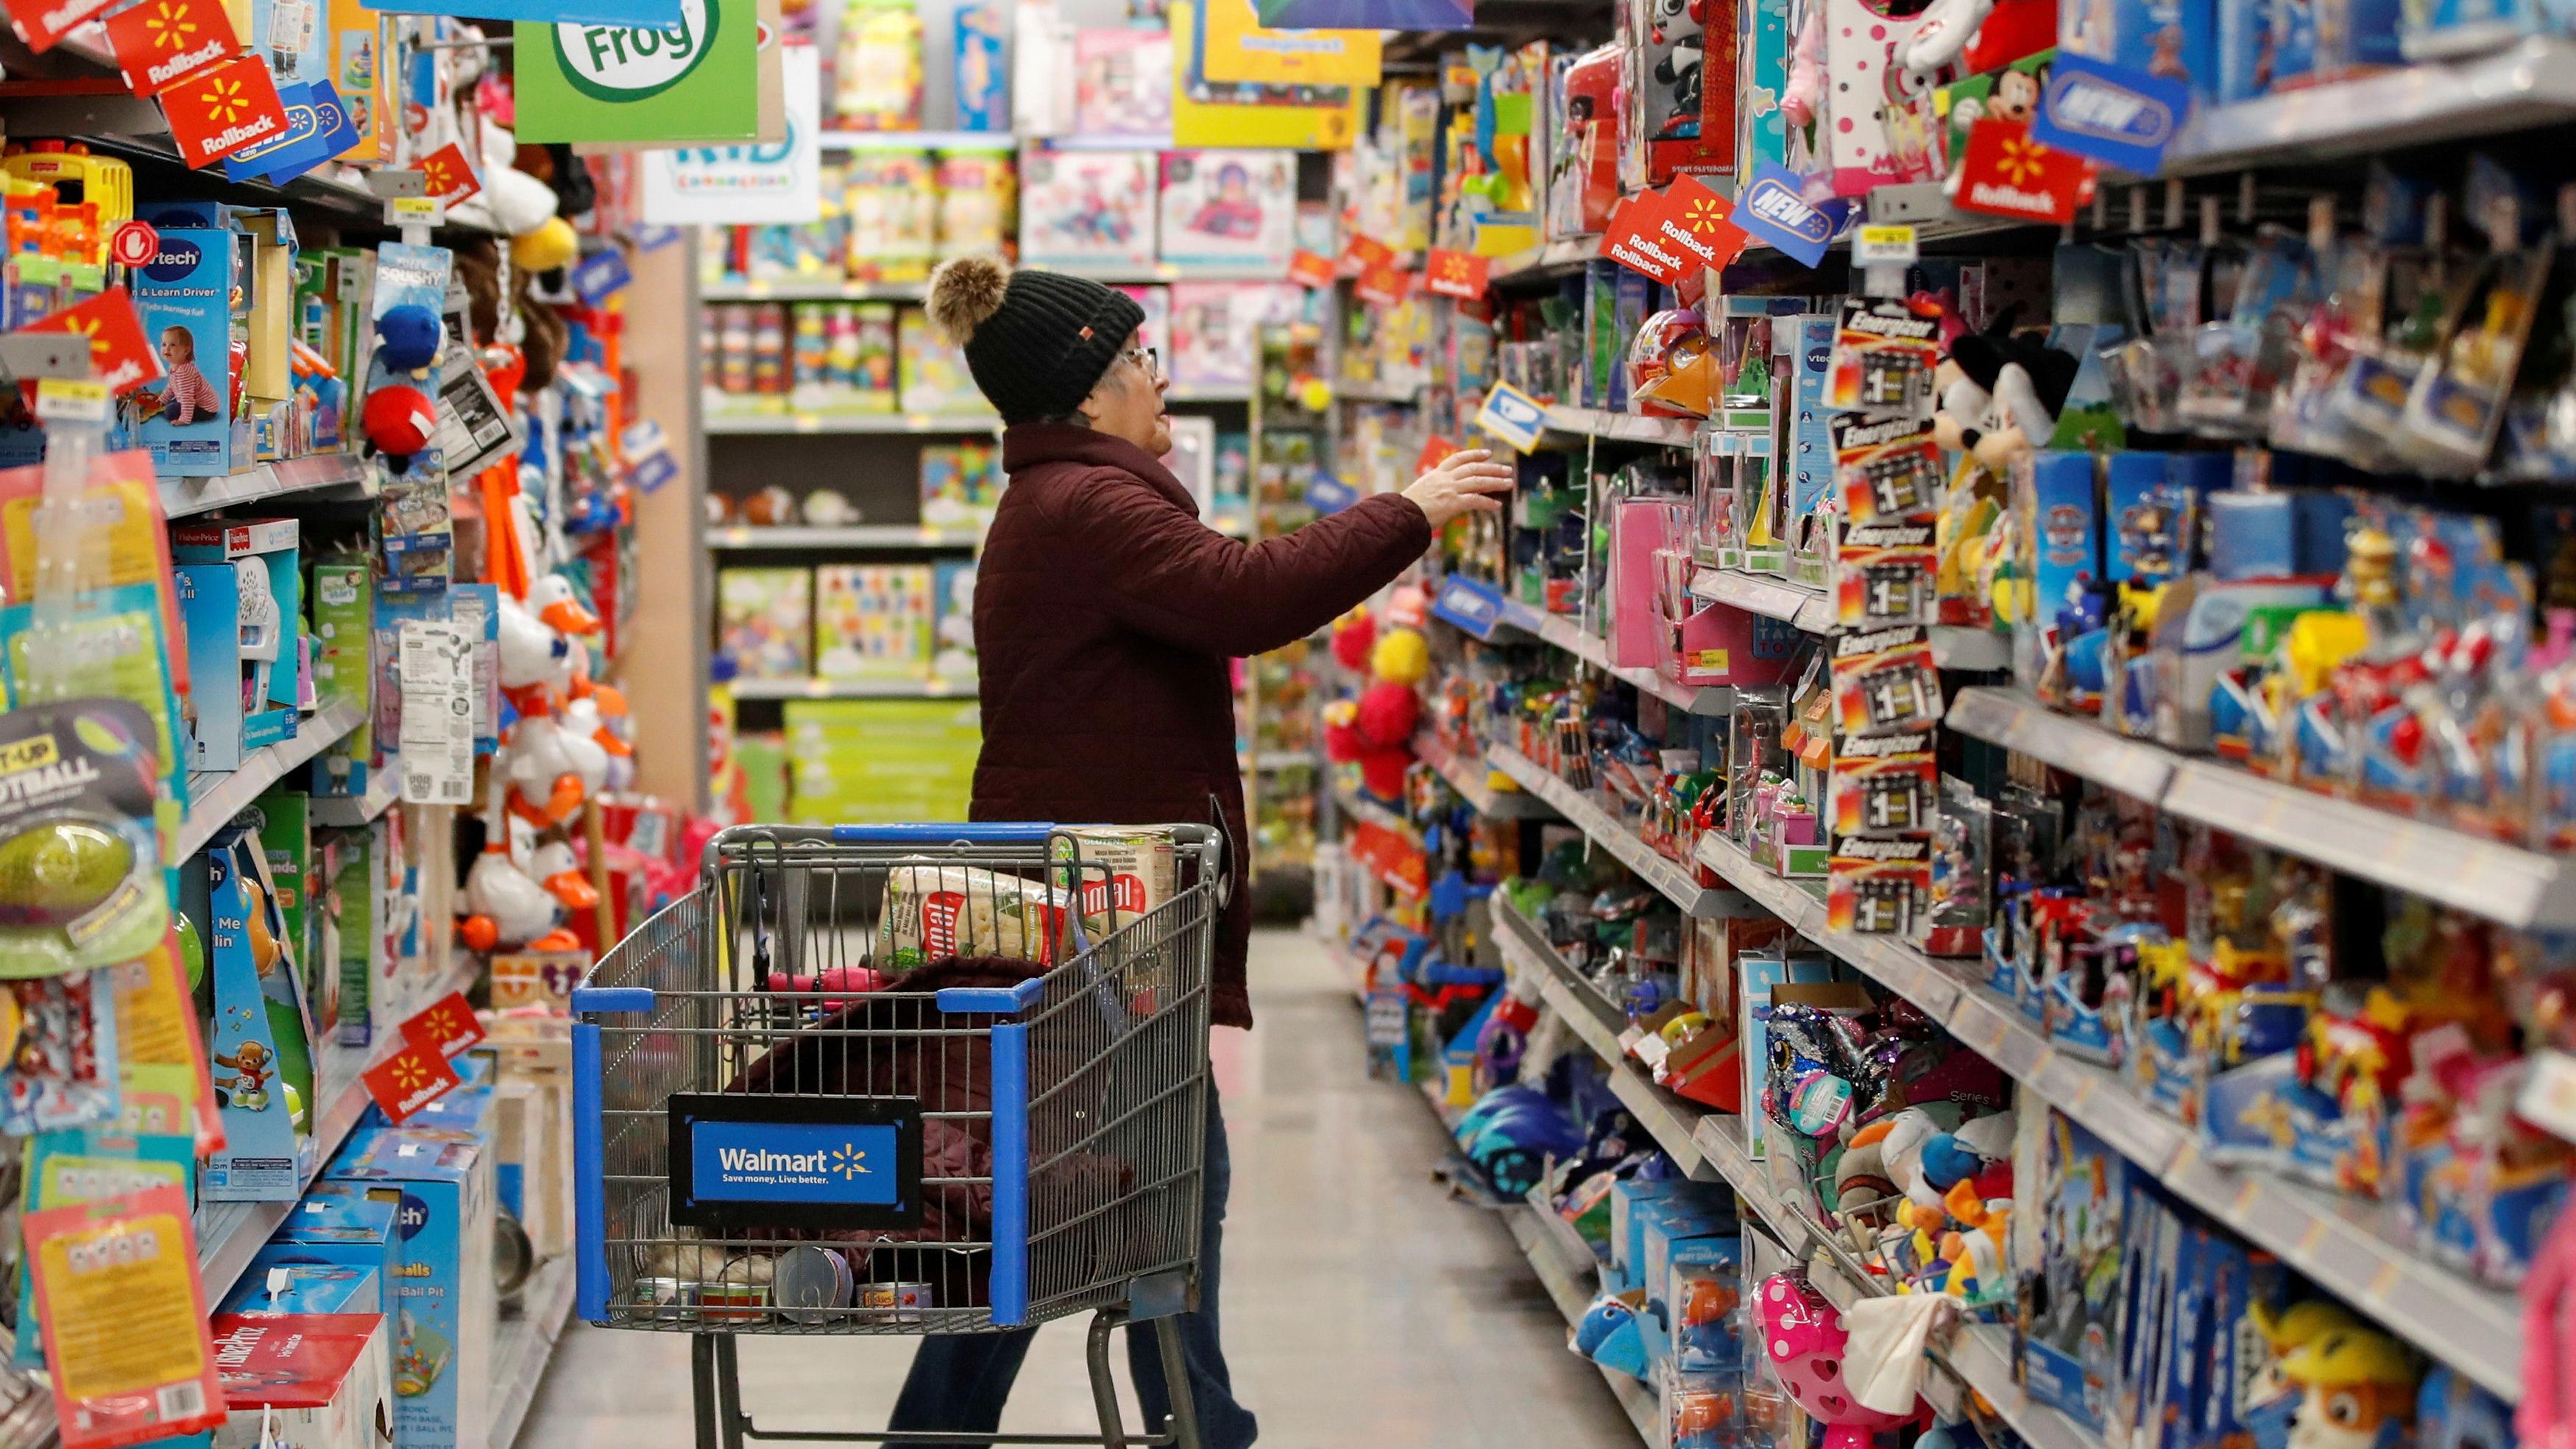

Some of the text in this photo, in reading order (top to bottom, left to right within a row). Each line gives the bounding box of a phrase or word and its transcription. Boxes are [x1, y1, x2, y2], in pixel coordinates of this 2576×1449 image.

[584, 10, 693, 72] Frog
[148, 40, 225, 85] Rollback
[201, 114, 276, 155] Rollback
[1754, 188, 1816, 227] NEW
[1629, 234, 1684, 271] Rollback
[1660, 219, 1716, 262] Rollback
[1611, 244, 1664, 277] Rollback
[152, 288, 180, 297] Learn
[183, 288, 215, 297] Driver
[1847, 311, 1935, 338] Energizer
[1808, 355, 1832, 363] vtec
[178, 533, 219, 542] Fisher-Price
[1844, 525, 1931, 549] Energizer
[1837, 626, 1919, 657] Energizer
[1841, 735, 1927, 758] Energizer
[1838, 837, 1925, 862] Energizer
[219, 917, 241, 929] Me
[398, 1077, 450, 1114] Rollback
[1950, 1090, 1990, 1105] Series
[719, 1148, 827, 1172] Walmart
[723, 1174, 829, 1185] Save money. Live better.
[400, 1287, 445, 1297] Ball Pit
